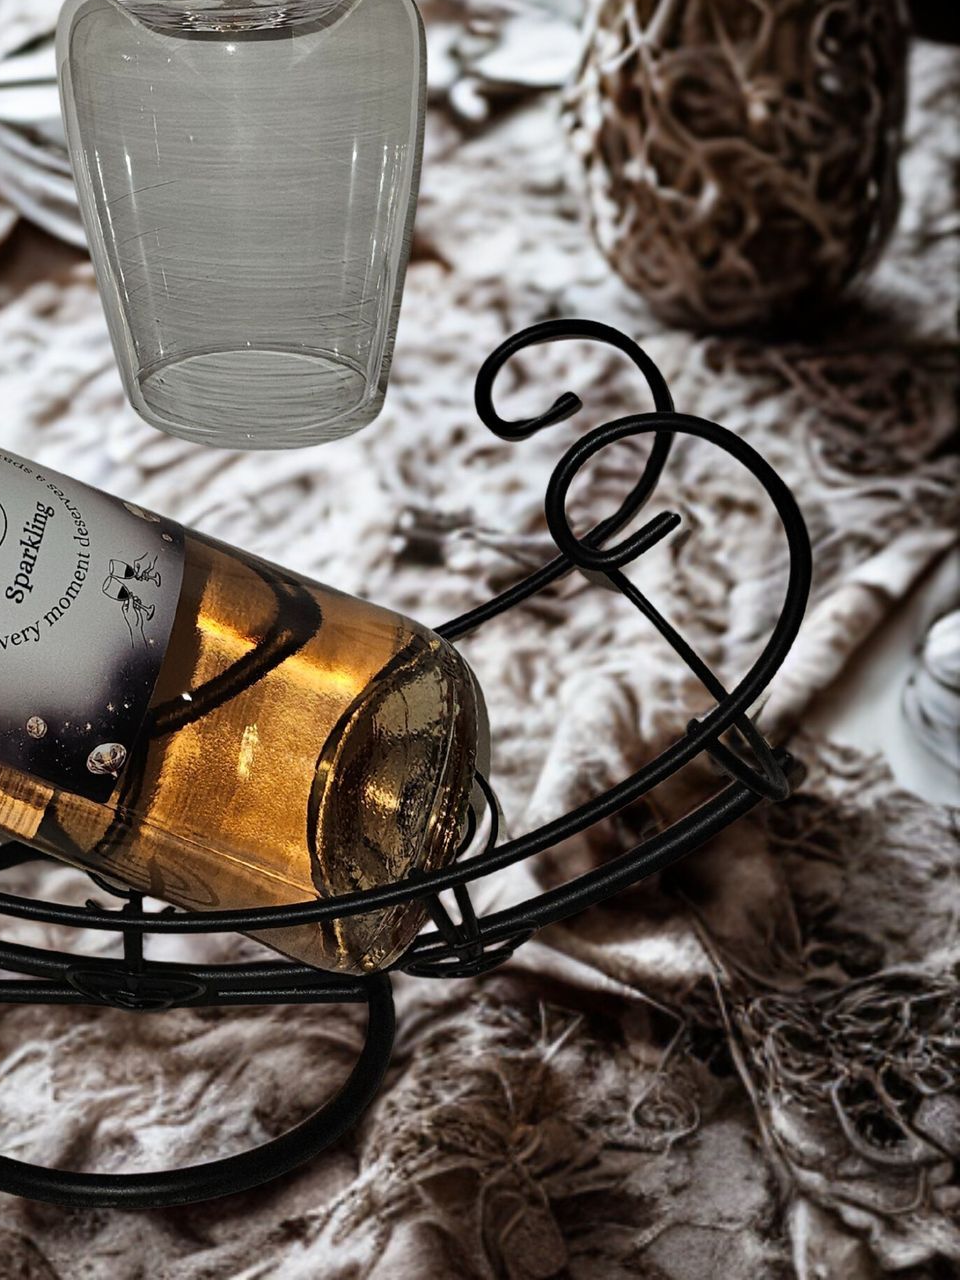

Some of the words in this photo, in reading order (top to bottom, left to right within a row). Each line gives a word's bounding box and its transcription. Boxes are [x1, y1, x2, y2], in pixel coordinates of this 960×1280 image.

[35, 474, 47, 483] a
[46, 483, 91, 548] deserves
[5, 501, 55, 604] Sparkling
[44, 552, 91, 626] moment
